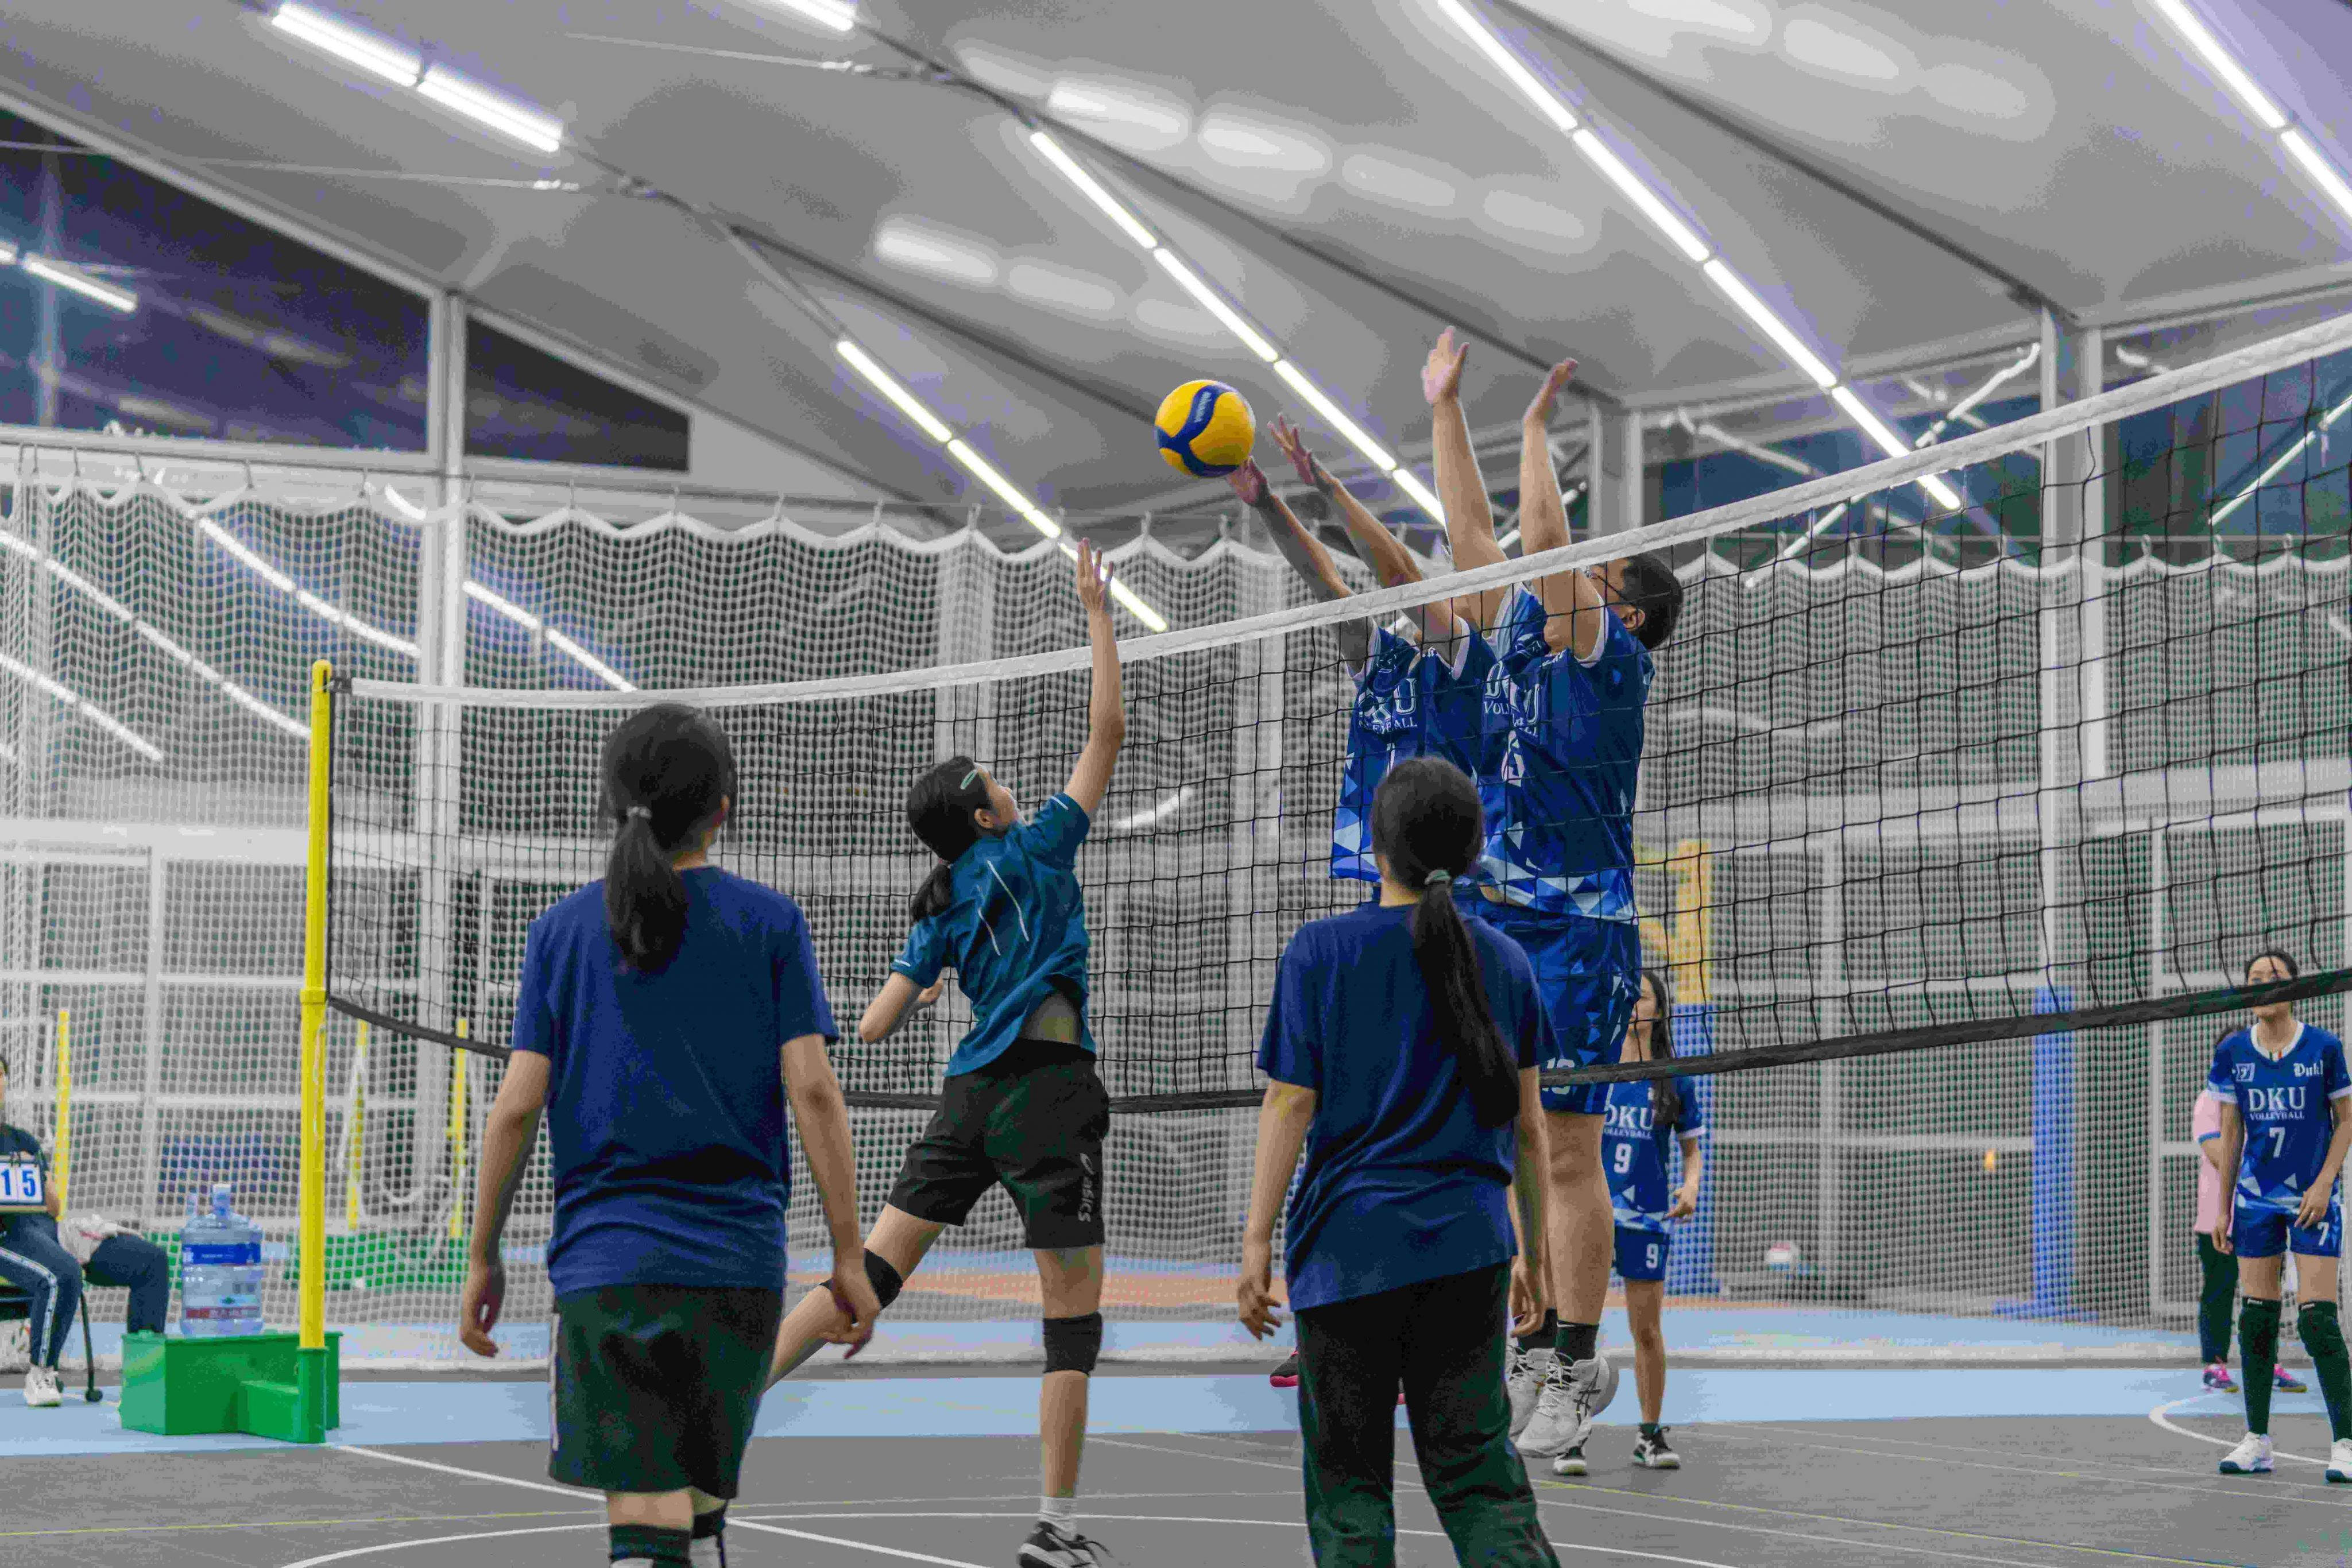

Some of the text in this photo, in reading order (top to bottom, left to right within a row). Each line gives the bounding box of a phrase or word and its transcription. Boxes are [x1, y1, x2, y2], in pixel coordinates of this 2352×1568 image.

[2247, 1086, 2306, 1112] DKU
[2249, 1110, 2305, 1120] VOLLEYBALL
[1604, 1126, 1653, 1140] OLLEYBALL
[2269, 1126, 2285, 1158] 7
[1613, 1143, 1632, 1174] 9
[1, 1168, 36, 1197] 15
[2317, 1221, 2329, 1246] 7
[1645, 1242, 1659, 1269] 9
